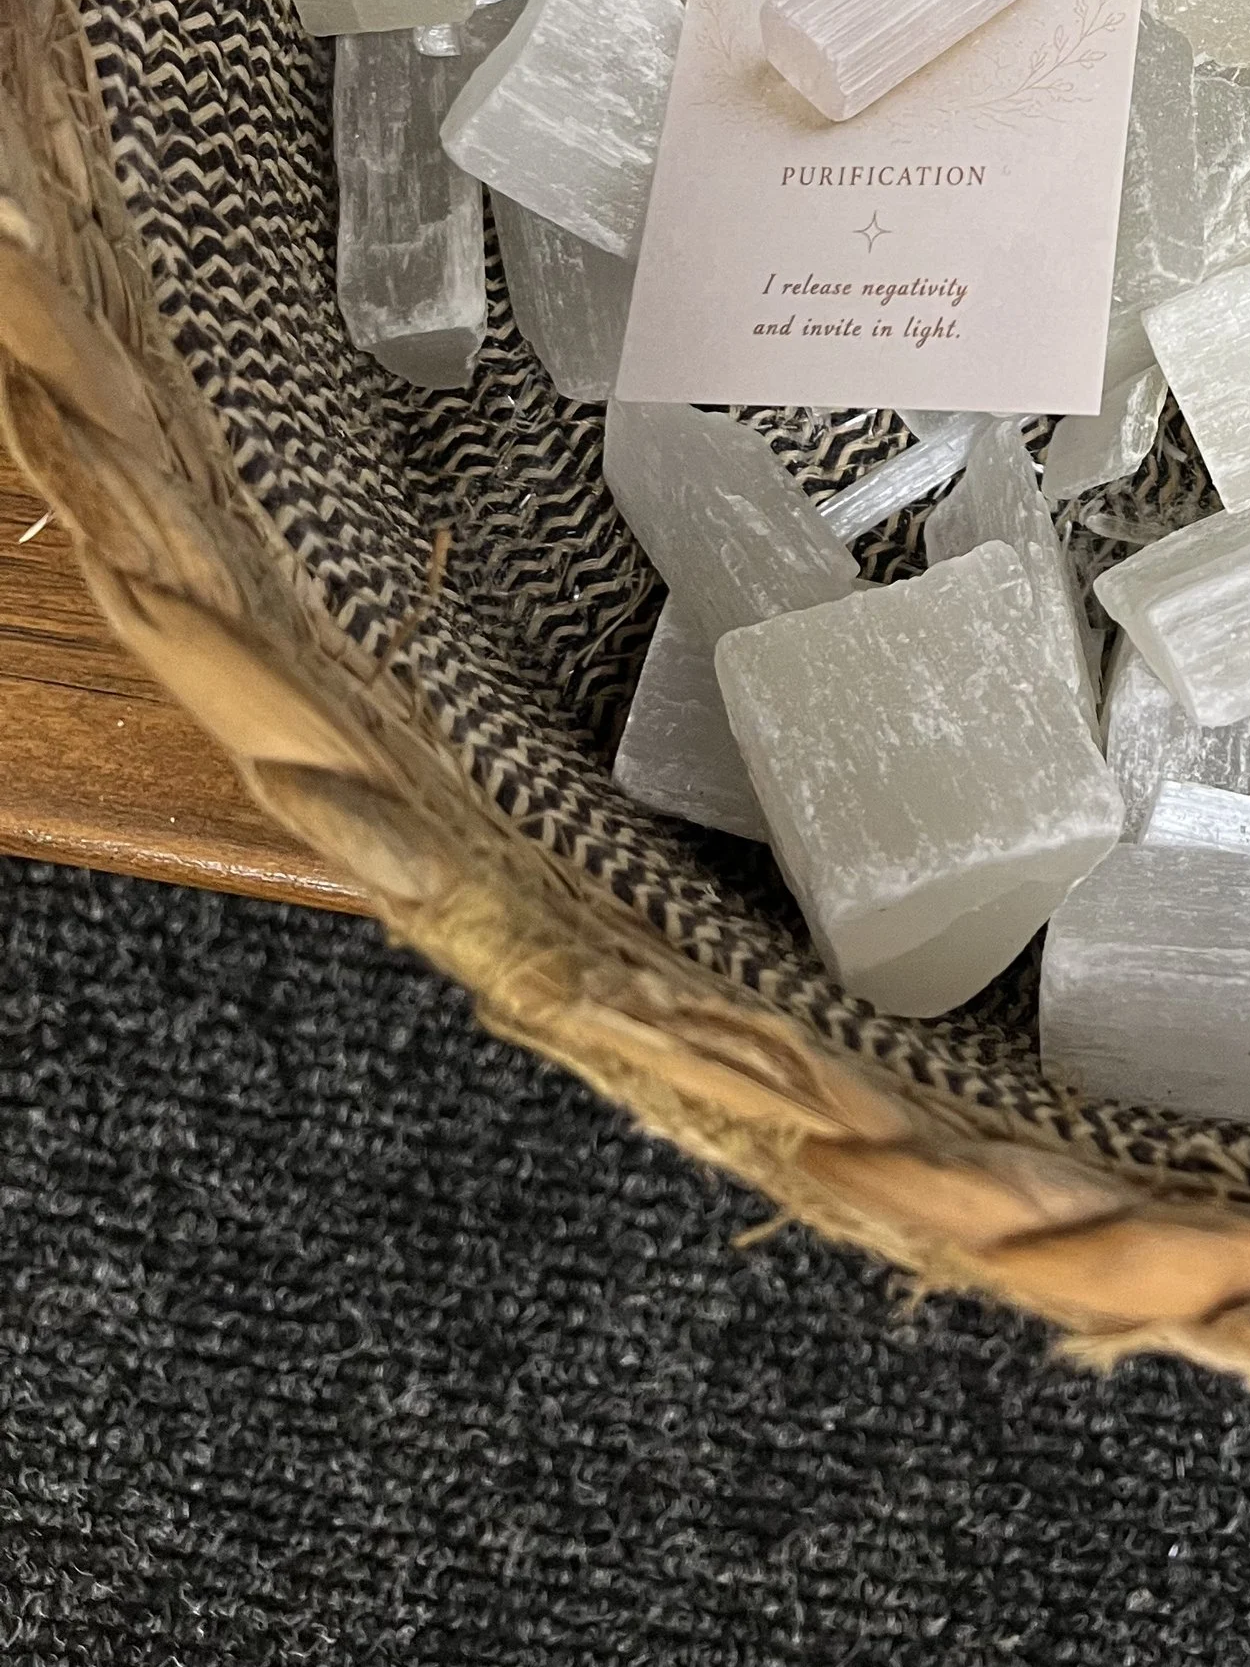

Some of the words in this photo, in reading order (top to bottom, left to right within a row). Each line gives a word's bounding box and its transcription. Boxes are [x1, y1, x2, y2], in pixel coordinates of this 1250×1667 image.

[781, 166, 987, 186] PURIFICATION
[762, 273, 776, 295] I
[782, 273, 852, 295] release
[861, 278, 969, 307] negativity
[753, 314, 796, 335] and
[802, 318, 862, 336] invite
[872, 319, 893, 337] in
[903, 316, 961, 349] light.
